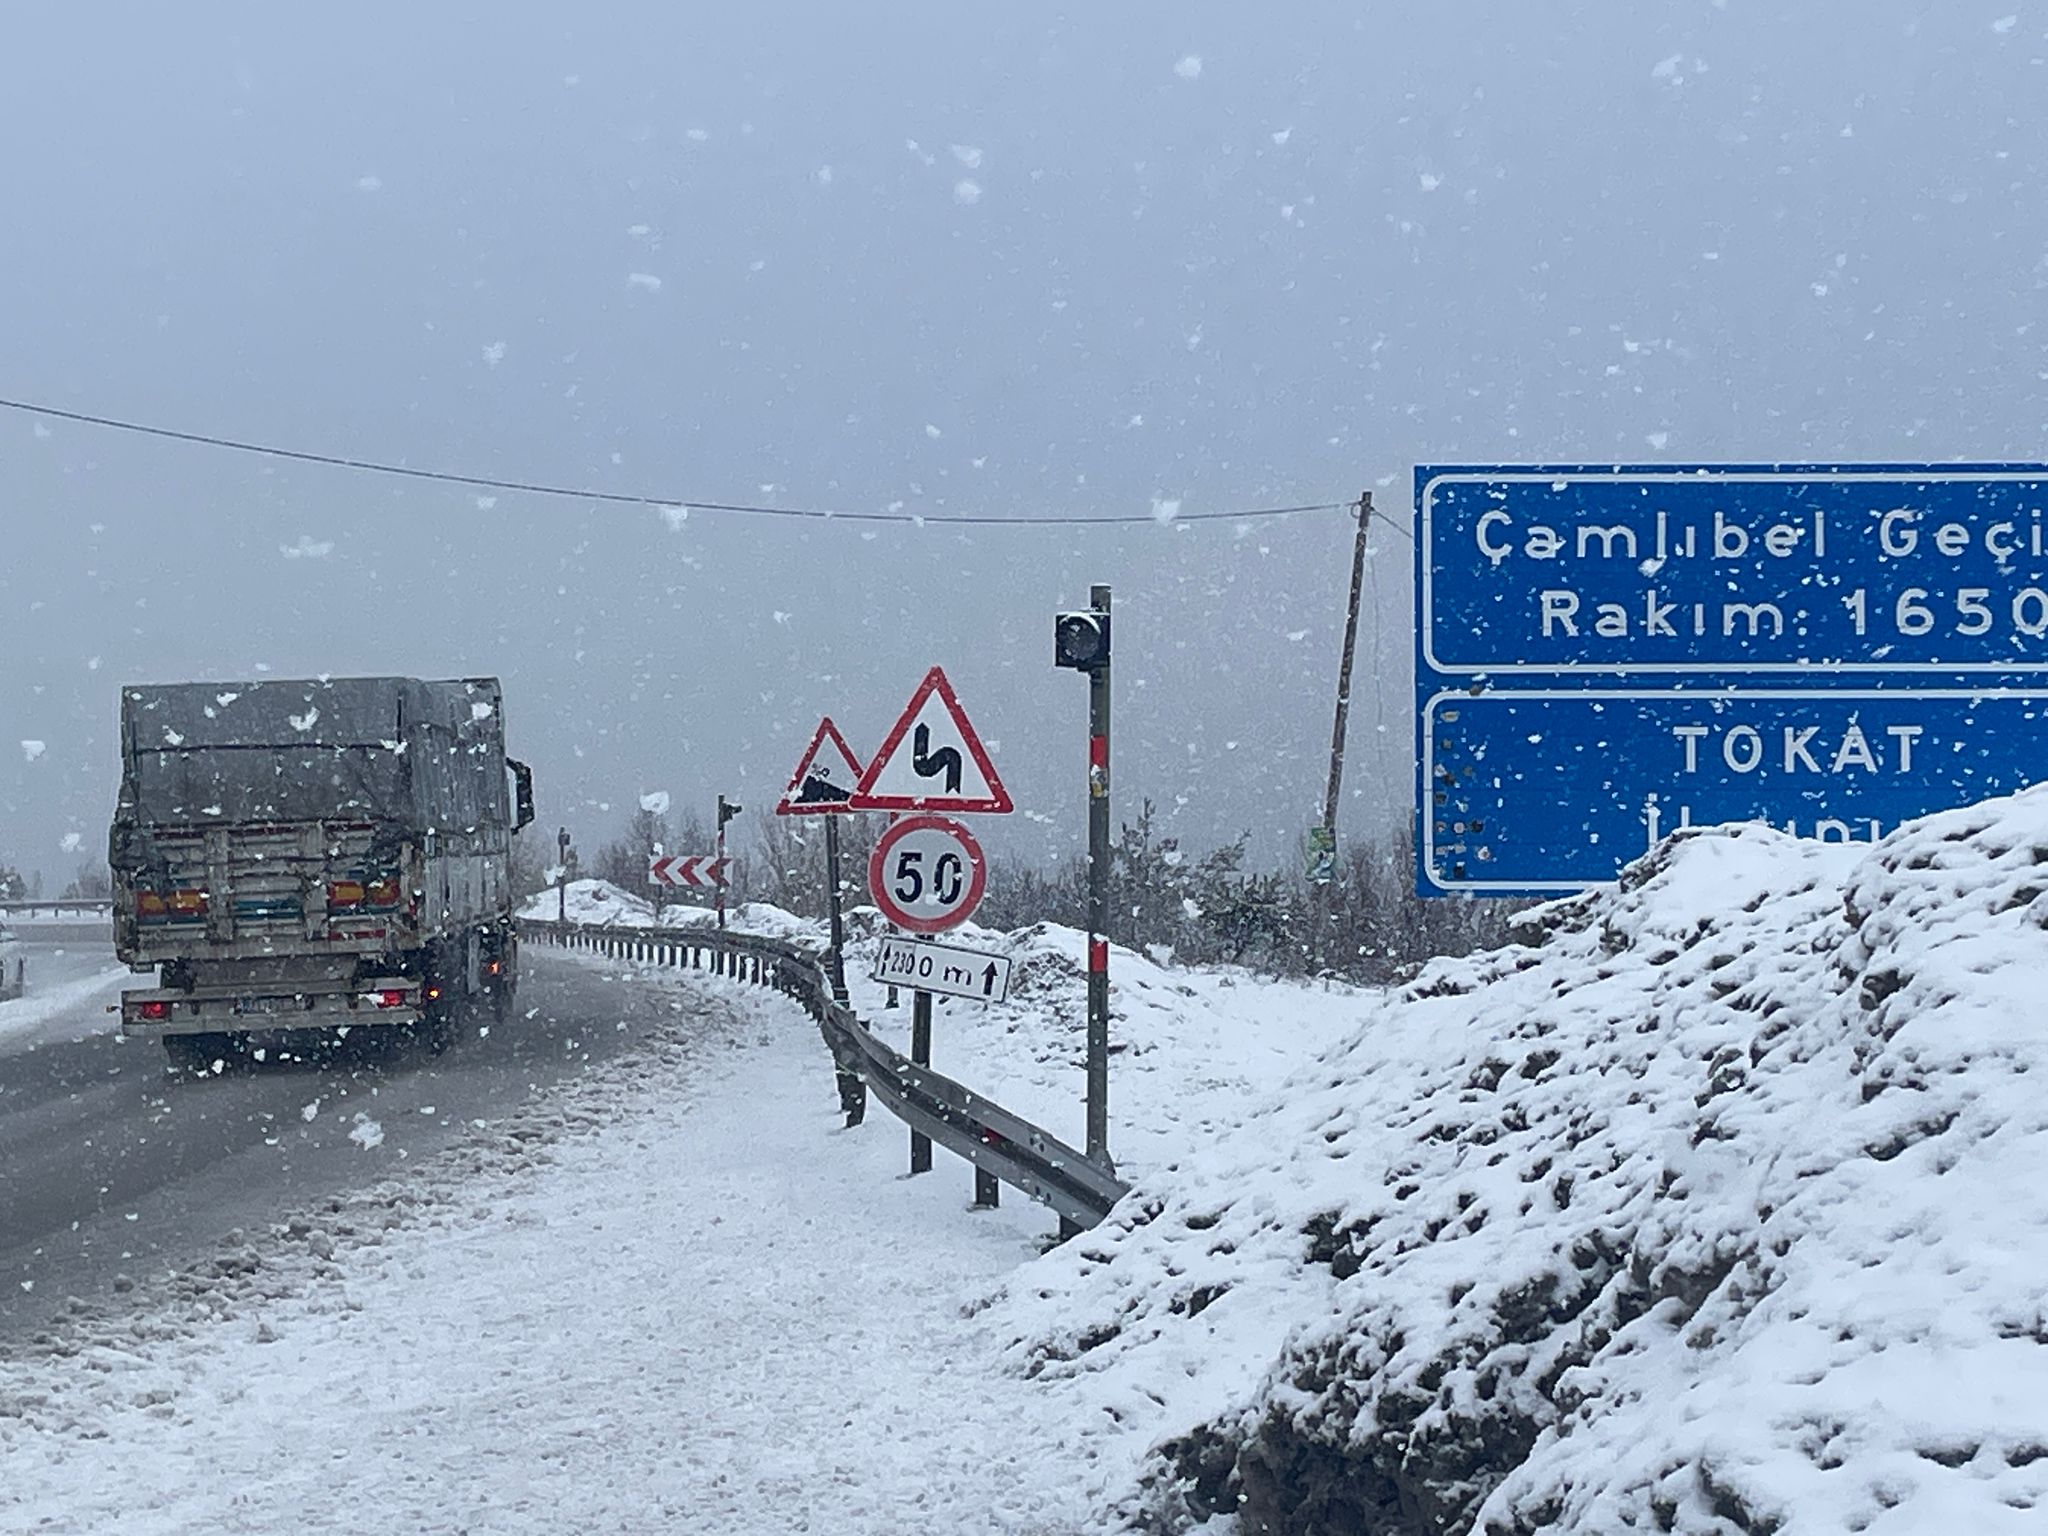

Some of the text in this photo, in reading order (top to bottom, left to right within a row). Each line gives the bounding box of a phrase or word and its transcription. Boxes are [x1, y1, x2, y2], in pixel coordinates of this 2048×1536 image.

[1475, 509, 1825, 566] Çamlıbel
[1541, 587, 2048, 637] Rakım: 1650
[1673, 725, 1924, 773] TOKAT
[895, 852, 962, 904] 50
[943, 965, 972, 986] m
